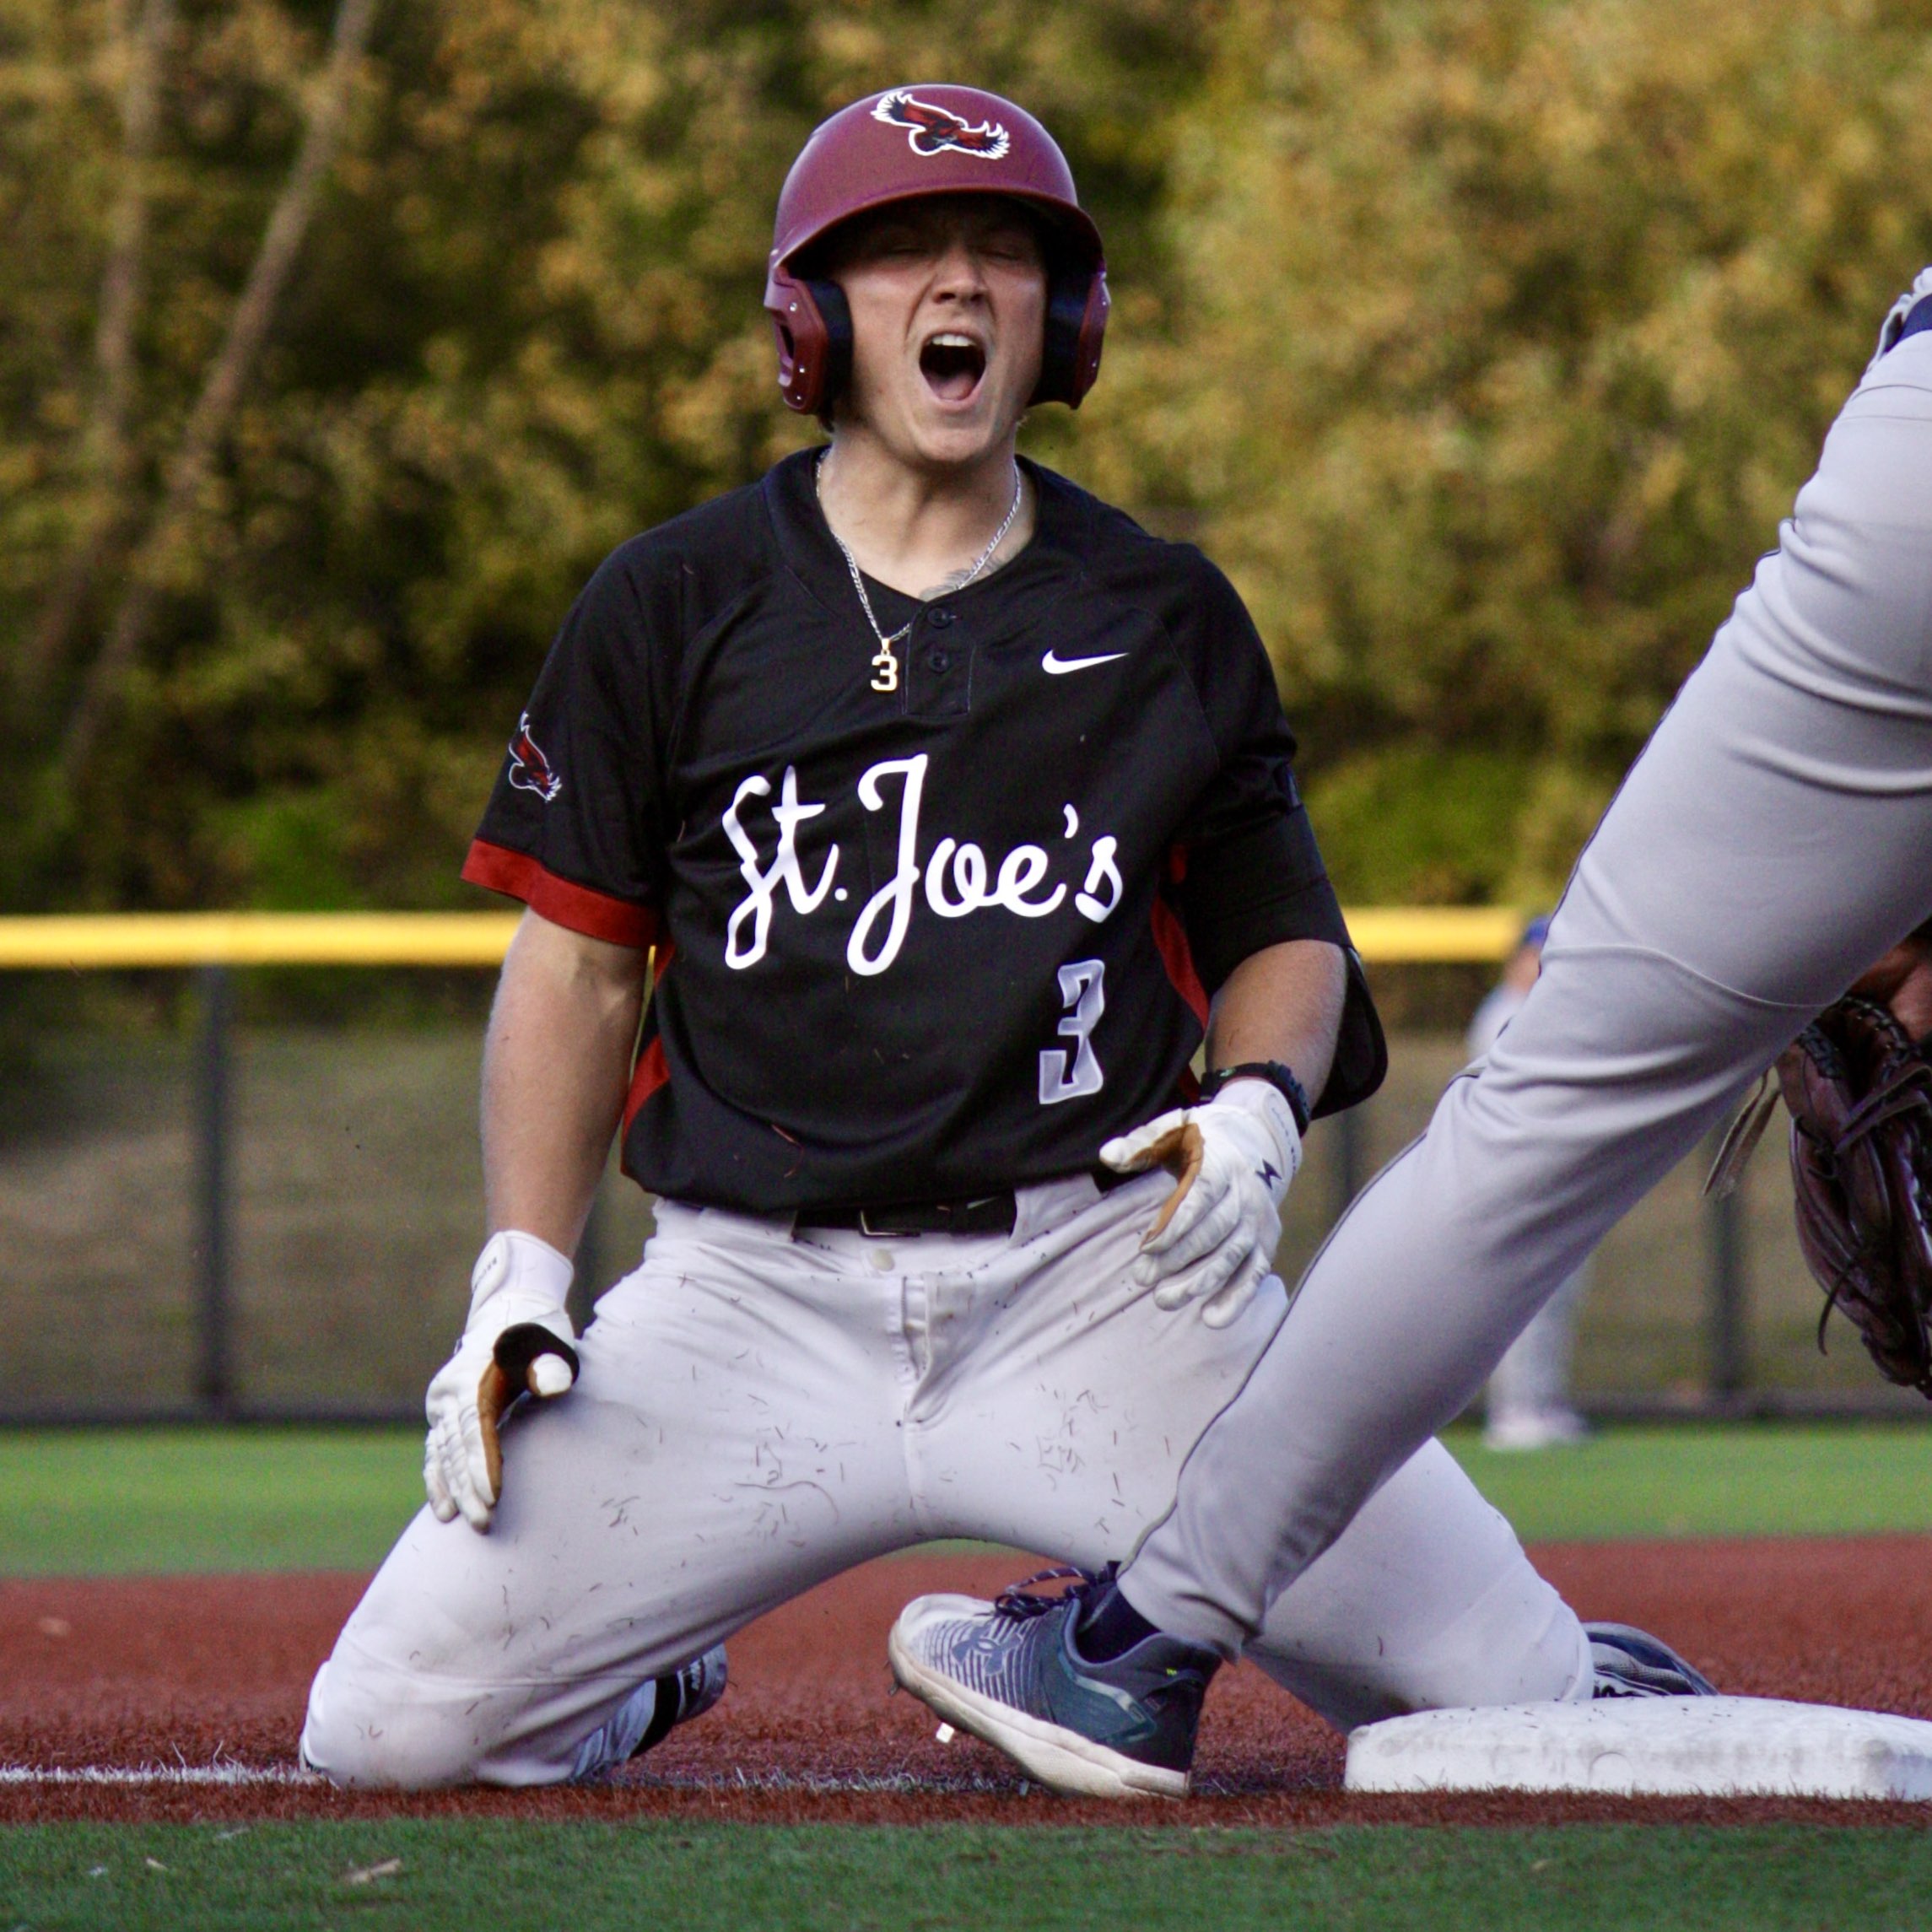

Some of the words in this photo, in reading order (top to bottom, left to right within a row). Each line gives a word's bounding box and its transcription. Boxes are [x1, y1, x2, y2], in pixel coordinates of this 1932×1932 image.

[870, 654, 899, 691] 3
[721, 764, 848, 970] St.
[846, 753, 1123, 976] Joe's
[1039, 958, 1105, 1105] 3
